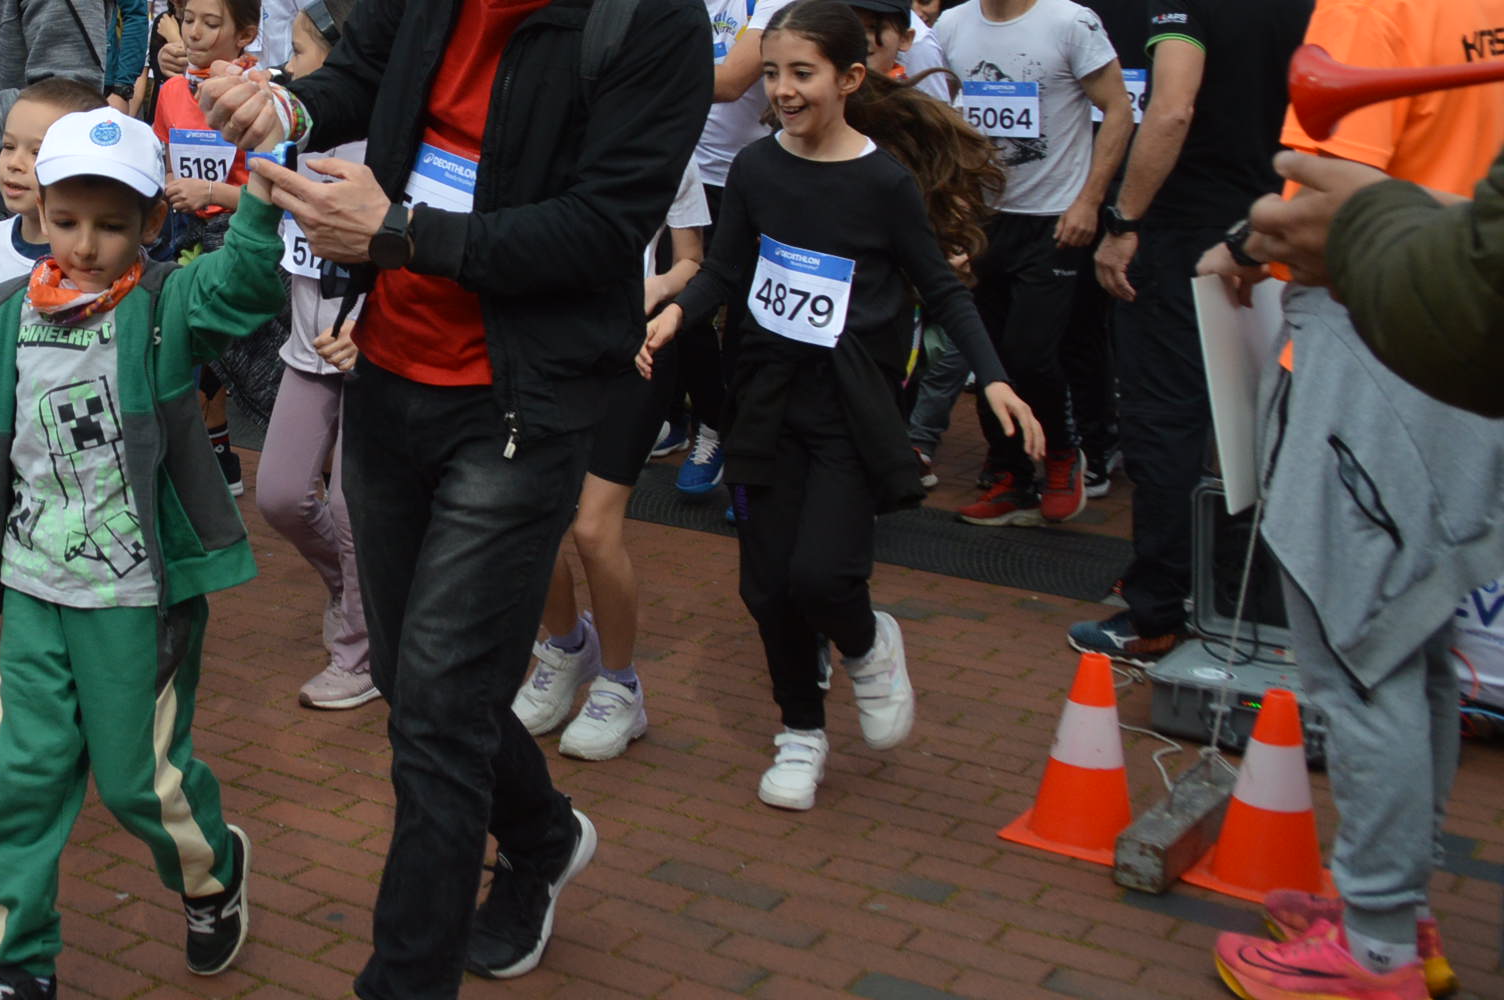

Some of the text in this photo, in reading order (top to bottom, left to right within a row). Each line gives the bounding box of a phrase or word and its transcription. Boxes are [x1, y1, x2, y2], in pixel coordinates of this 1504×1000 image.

[968, 107, 1033, 130] 5064
[179, 156, 228, 182] 5181
[755, 277, 835, 329] 4879
